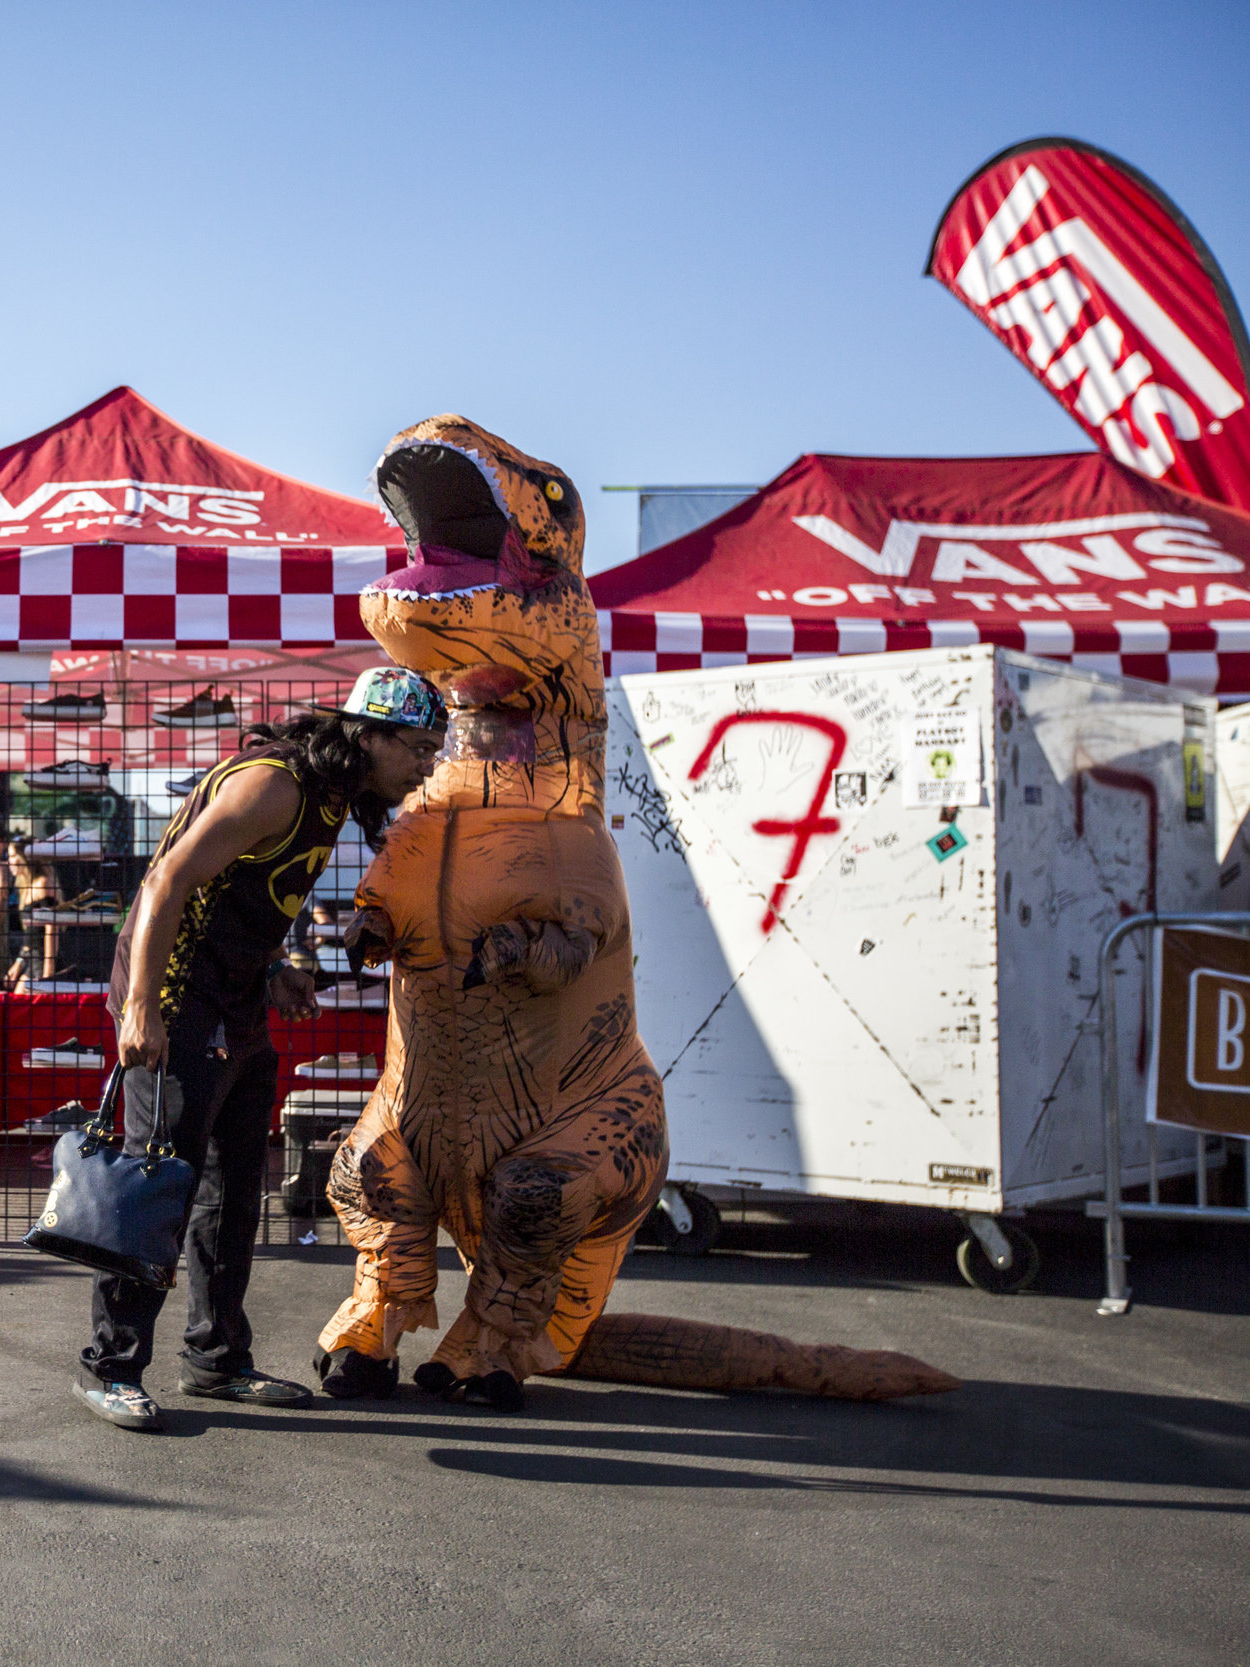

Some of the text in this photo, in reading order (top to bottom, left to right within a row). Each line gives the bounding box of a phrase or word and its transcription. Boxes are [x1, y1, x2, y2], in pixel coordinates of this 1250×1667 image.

[956, 163, 1245, 480] VANS
[43, 511, 143, 534] THE
[792, 511, 1246, 586] VANS
[953, 590, 1113, 613] THE
[687, 710, 849, 936] 7
